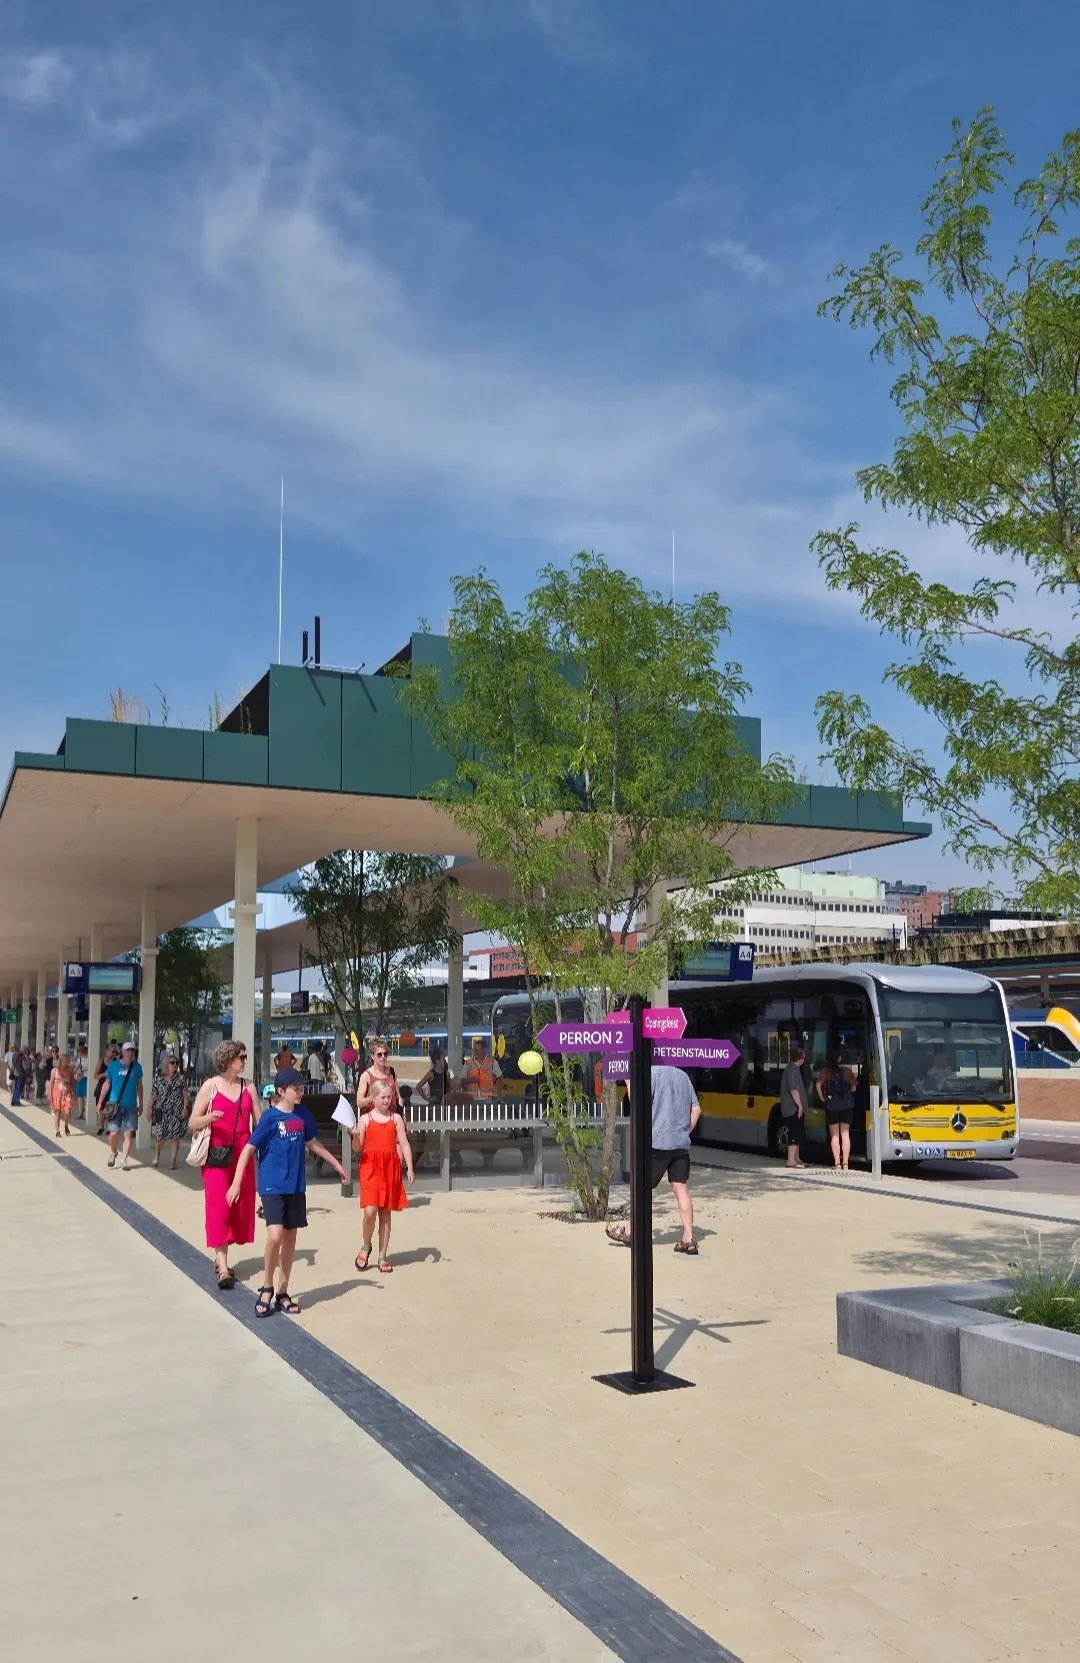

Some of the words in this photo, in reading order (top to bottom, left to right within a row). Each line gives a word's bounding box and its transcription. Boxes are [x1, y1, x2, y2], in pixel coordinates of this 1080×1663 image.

[740, 951, 751, 959] A4
[559, 1031, 612, 1045] PERRON
[615, 1031, 624, 1044] 2
[653, 1047, 730, 1059] FIETSENSTALLING
[608, 1060, 629, 1073] PERRON
